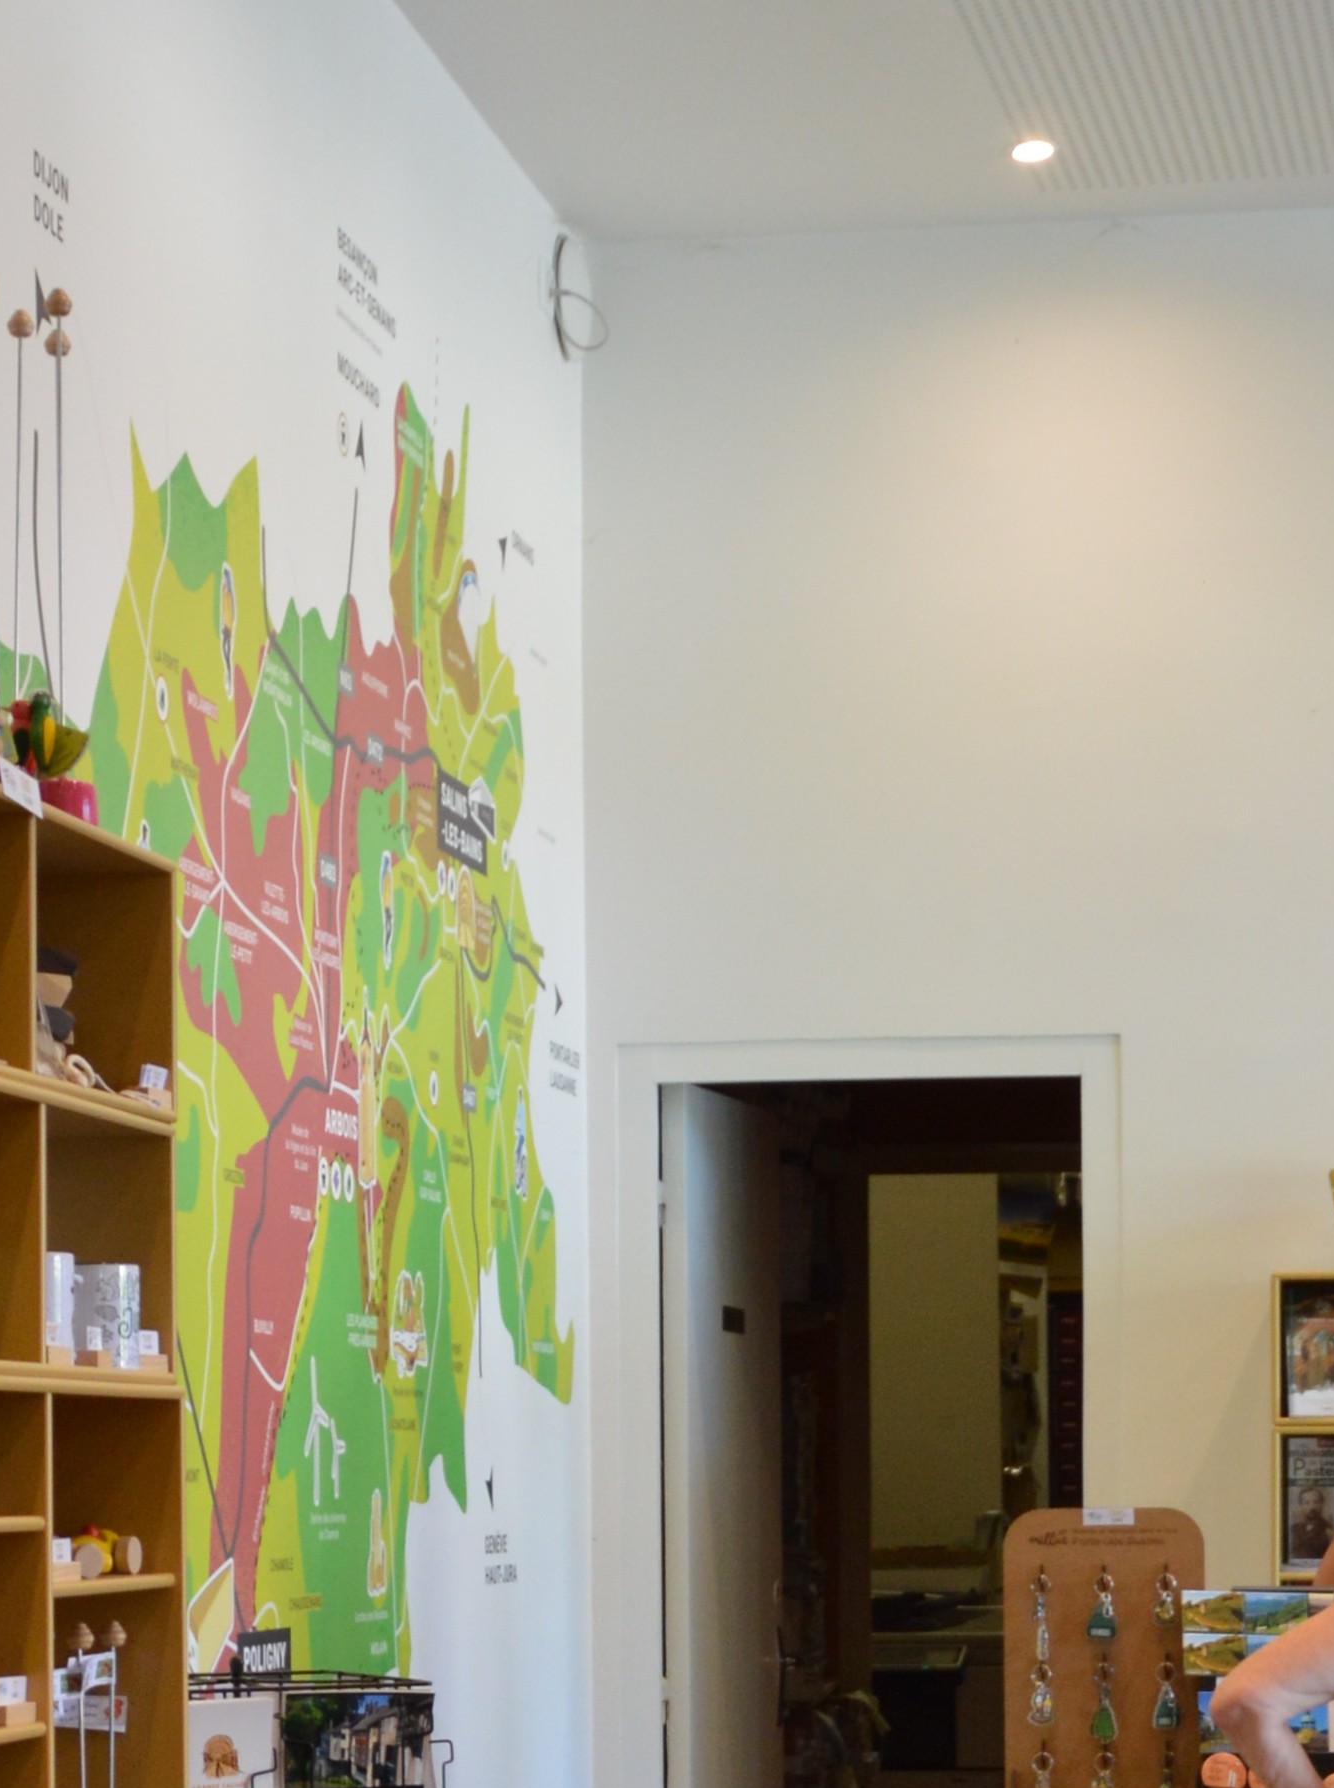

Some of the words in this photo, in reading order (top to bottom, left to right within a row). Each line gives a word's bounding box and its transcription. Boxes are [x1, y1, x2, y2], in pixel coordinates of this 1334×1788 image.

[33, 149, 69, 203] DIJON
[33, 194, 65, 242] DOLE
[336, 350, 380, 408] MOUCHARD
[441, 781, 468, 819] SALINS
[442, 820, 483, 864] -LES-BAINS
[325, 1107, 359, 1140] ARBOIS
[484, 1533, 508, 1555] GENÈVE
[484, 1563, 517, 1585] HAUT-JURA
[243, 1641, 287, 1671] POLIGNY
